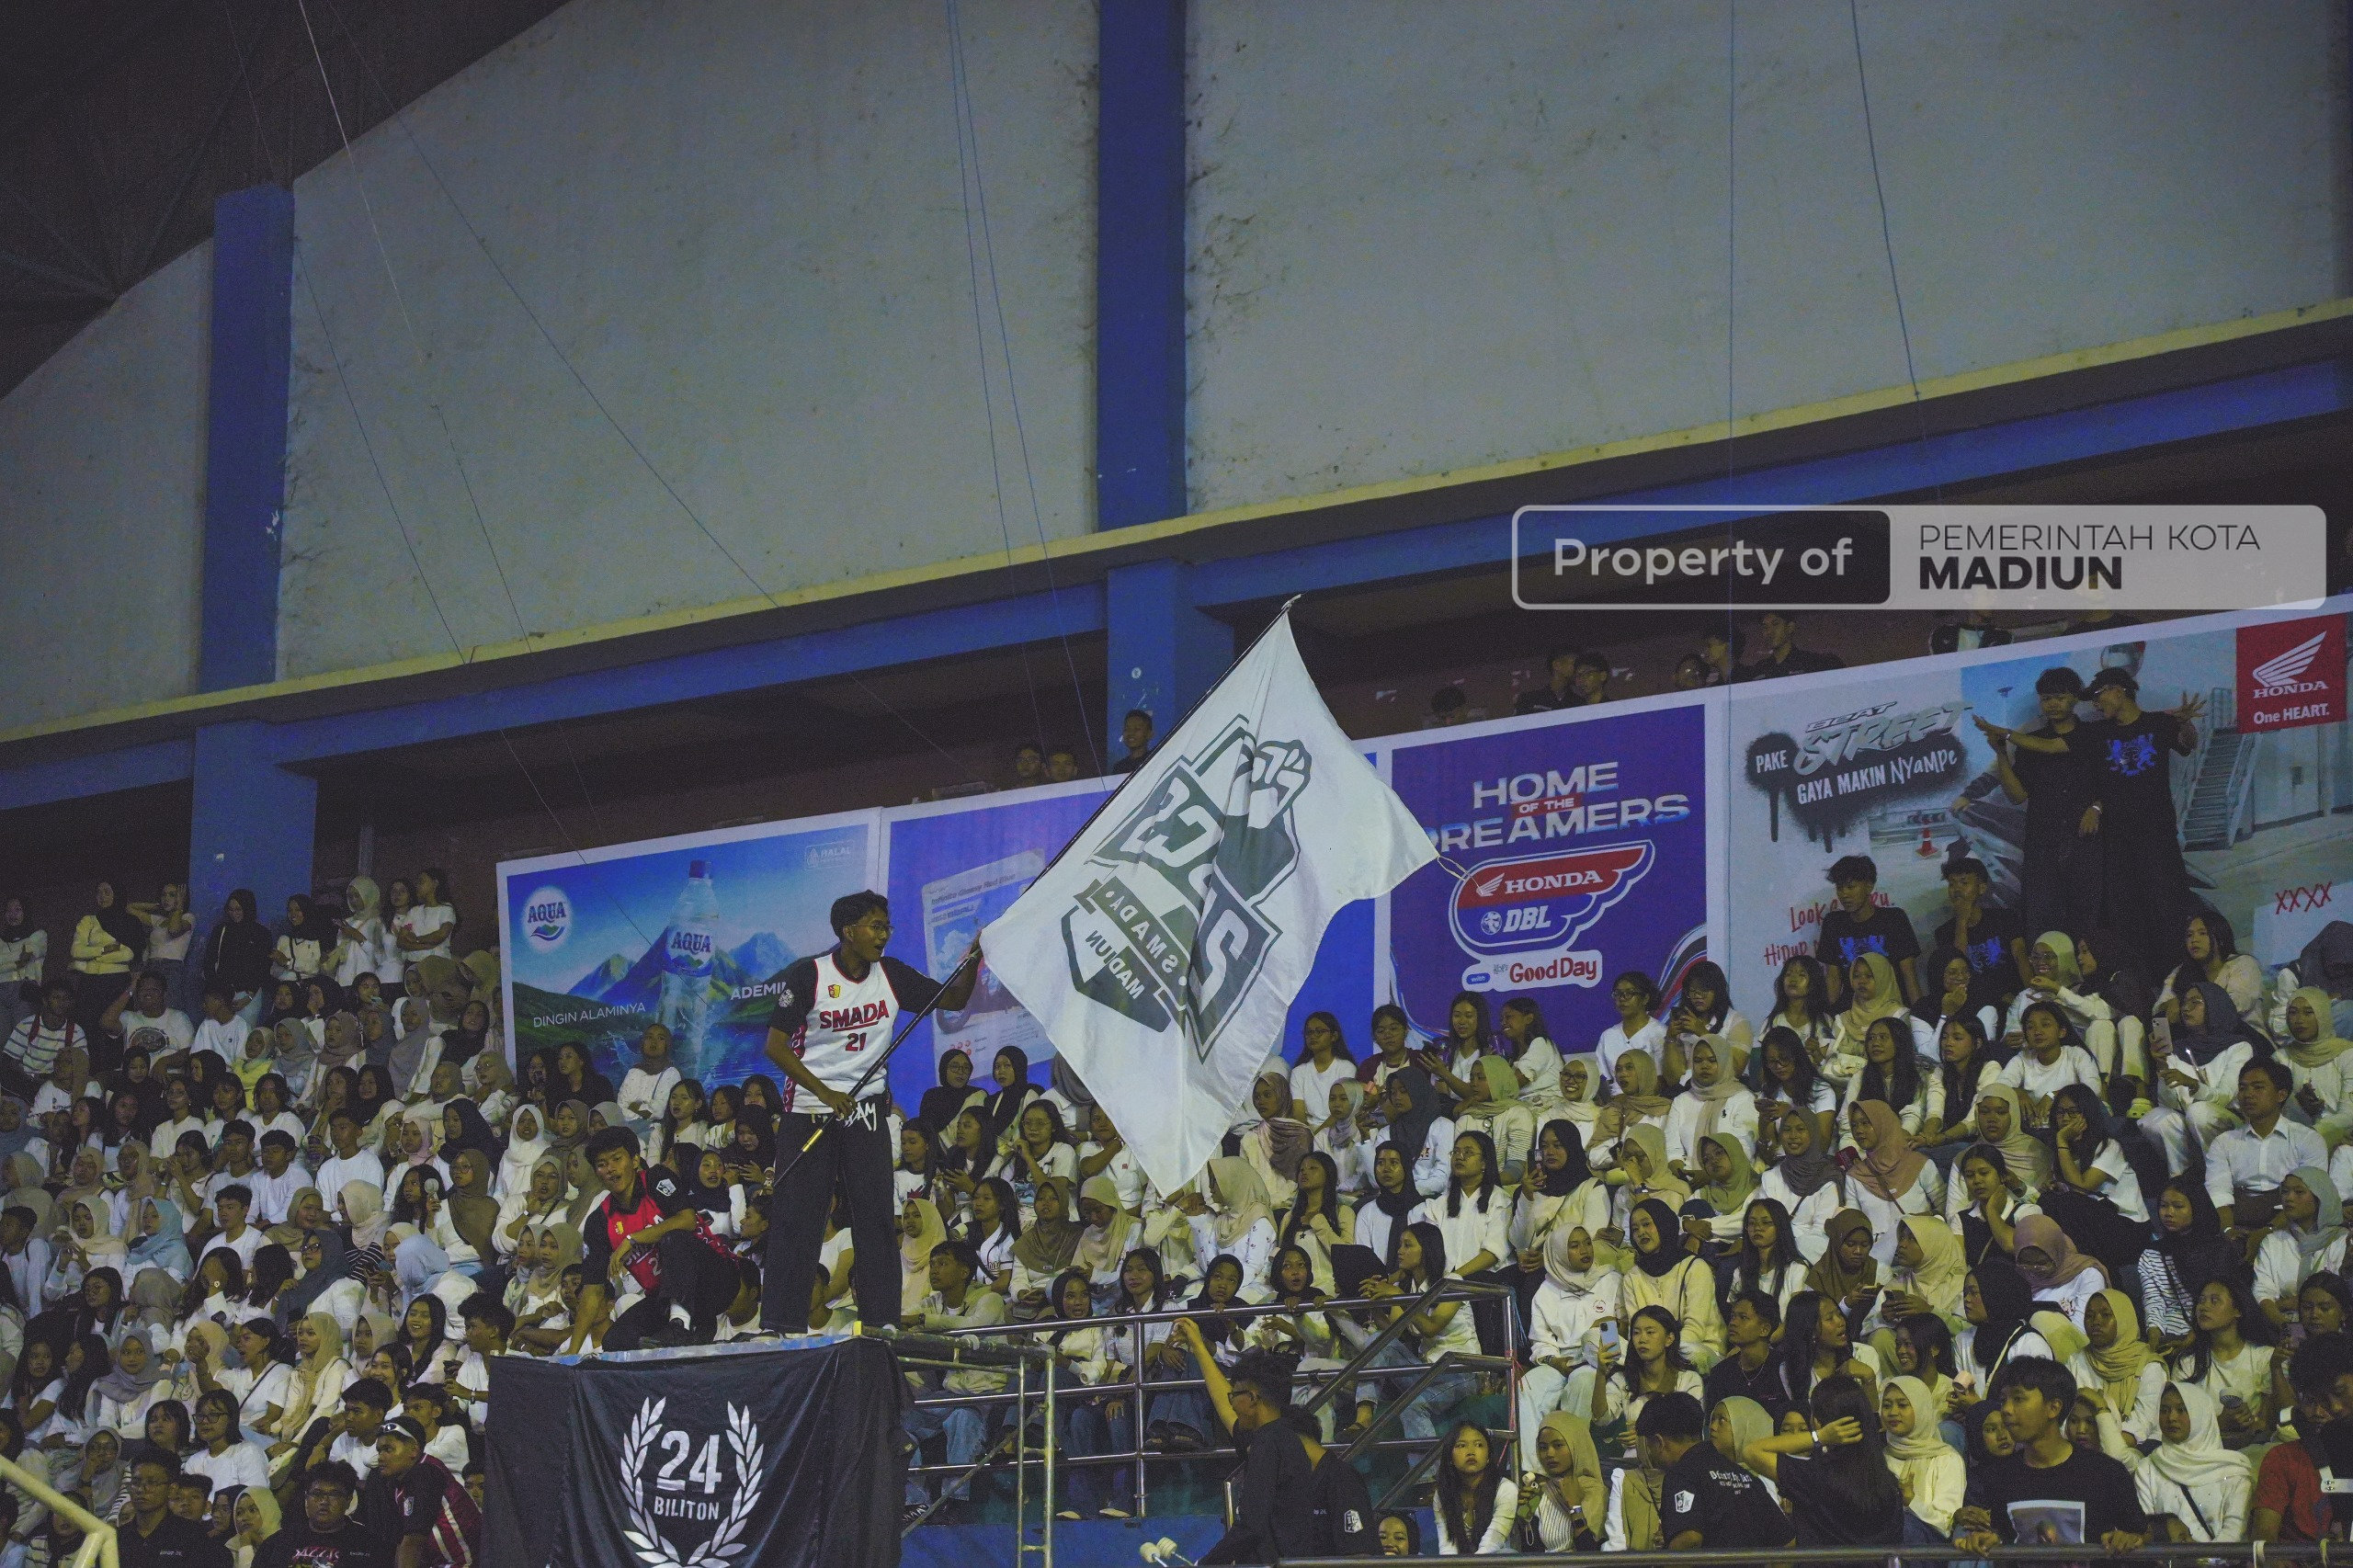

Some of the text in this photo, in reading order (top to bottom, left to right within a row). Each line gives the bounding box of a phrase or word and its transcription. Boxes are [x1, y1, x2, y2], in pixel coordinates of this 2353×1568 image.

[2254, 680, 2328, 699] HONDA
[2254, 703, 2329, 724] One HEART.
[1756, 701, 1972, 775] PAKE STREET
[1472, 761, 1619, 809] HOME
[1797, 778, 1833, 805] GAYA
[1837, 765, 1886, 796] MAKIN
[1519, 797, 1574, 813] OF THE
[1506, 869, 1603, 894] HONDA
[528, 902, 566, 924] AQUA
[1504, 906, 1552, 932] DBL
[671, 932, 711, 953] AQUA
[533, 1002, 646, 1028] DINGIN ALAMINYA
[820, 1000, 889, 1028] SMADA
[846, 1032, 866, 1051] 21
[657, 1430, 722, 1494] 24
[654, 1495, 720, 1520] BILITON
